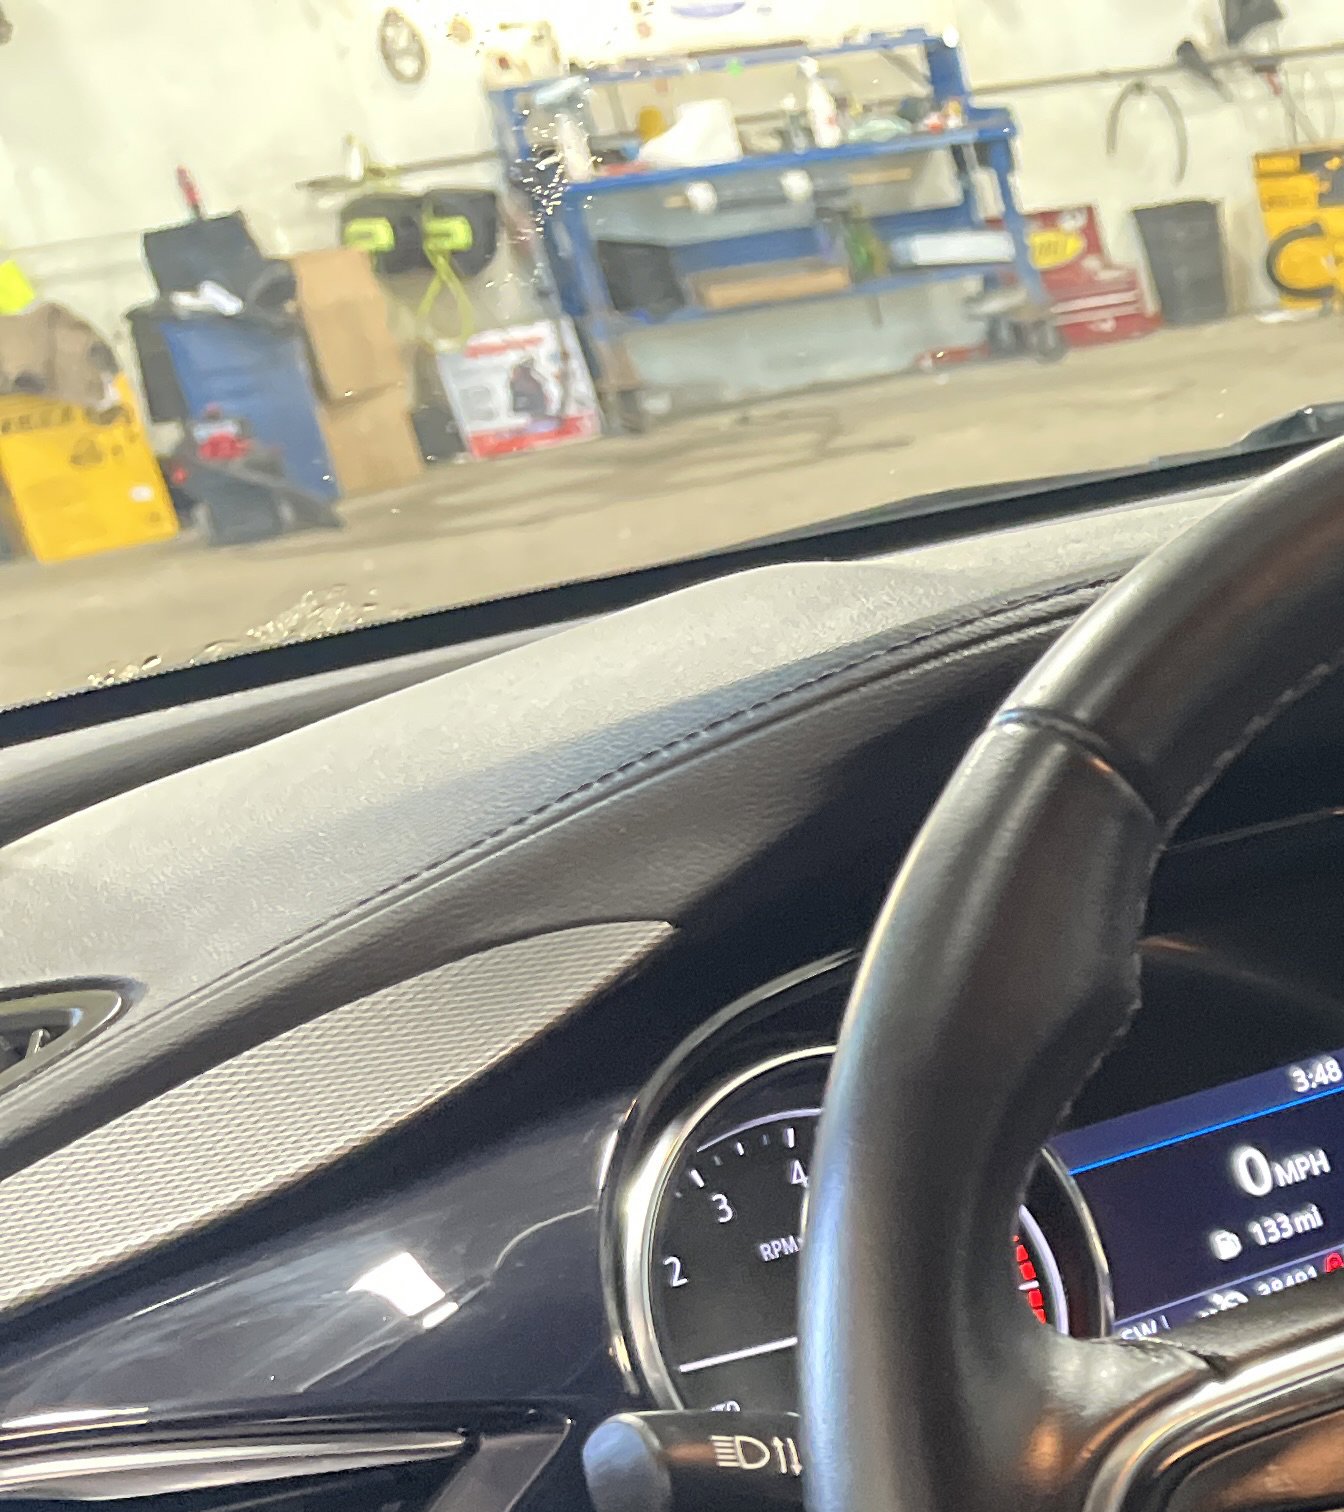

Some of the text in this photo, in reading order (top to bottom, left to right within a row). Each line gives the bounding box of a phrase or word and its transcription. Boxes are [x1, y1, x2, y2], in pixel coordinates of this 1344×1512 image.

[1291, 1056, 1343, 1093] 3:48
[790, 1159, 809, 1188] 4
[711, 1193, 733, 1223] 3
[759, 1235, 800, 1263] RPM
[663, 1256, 688, 1288] 2
